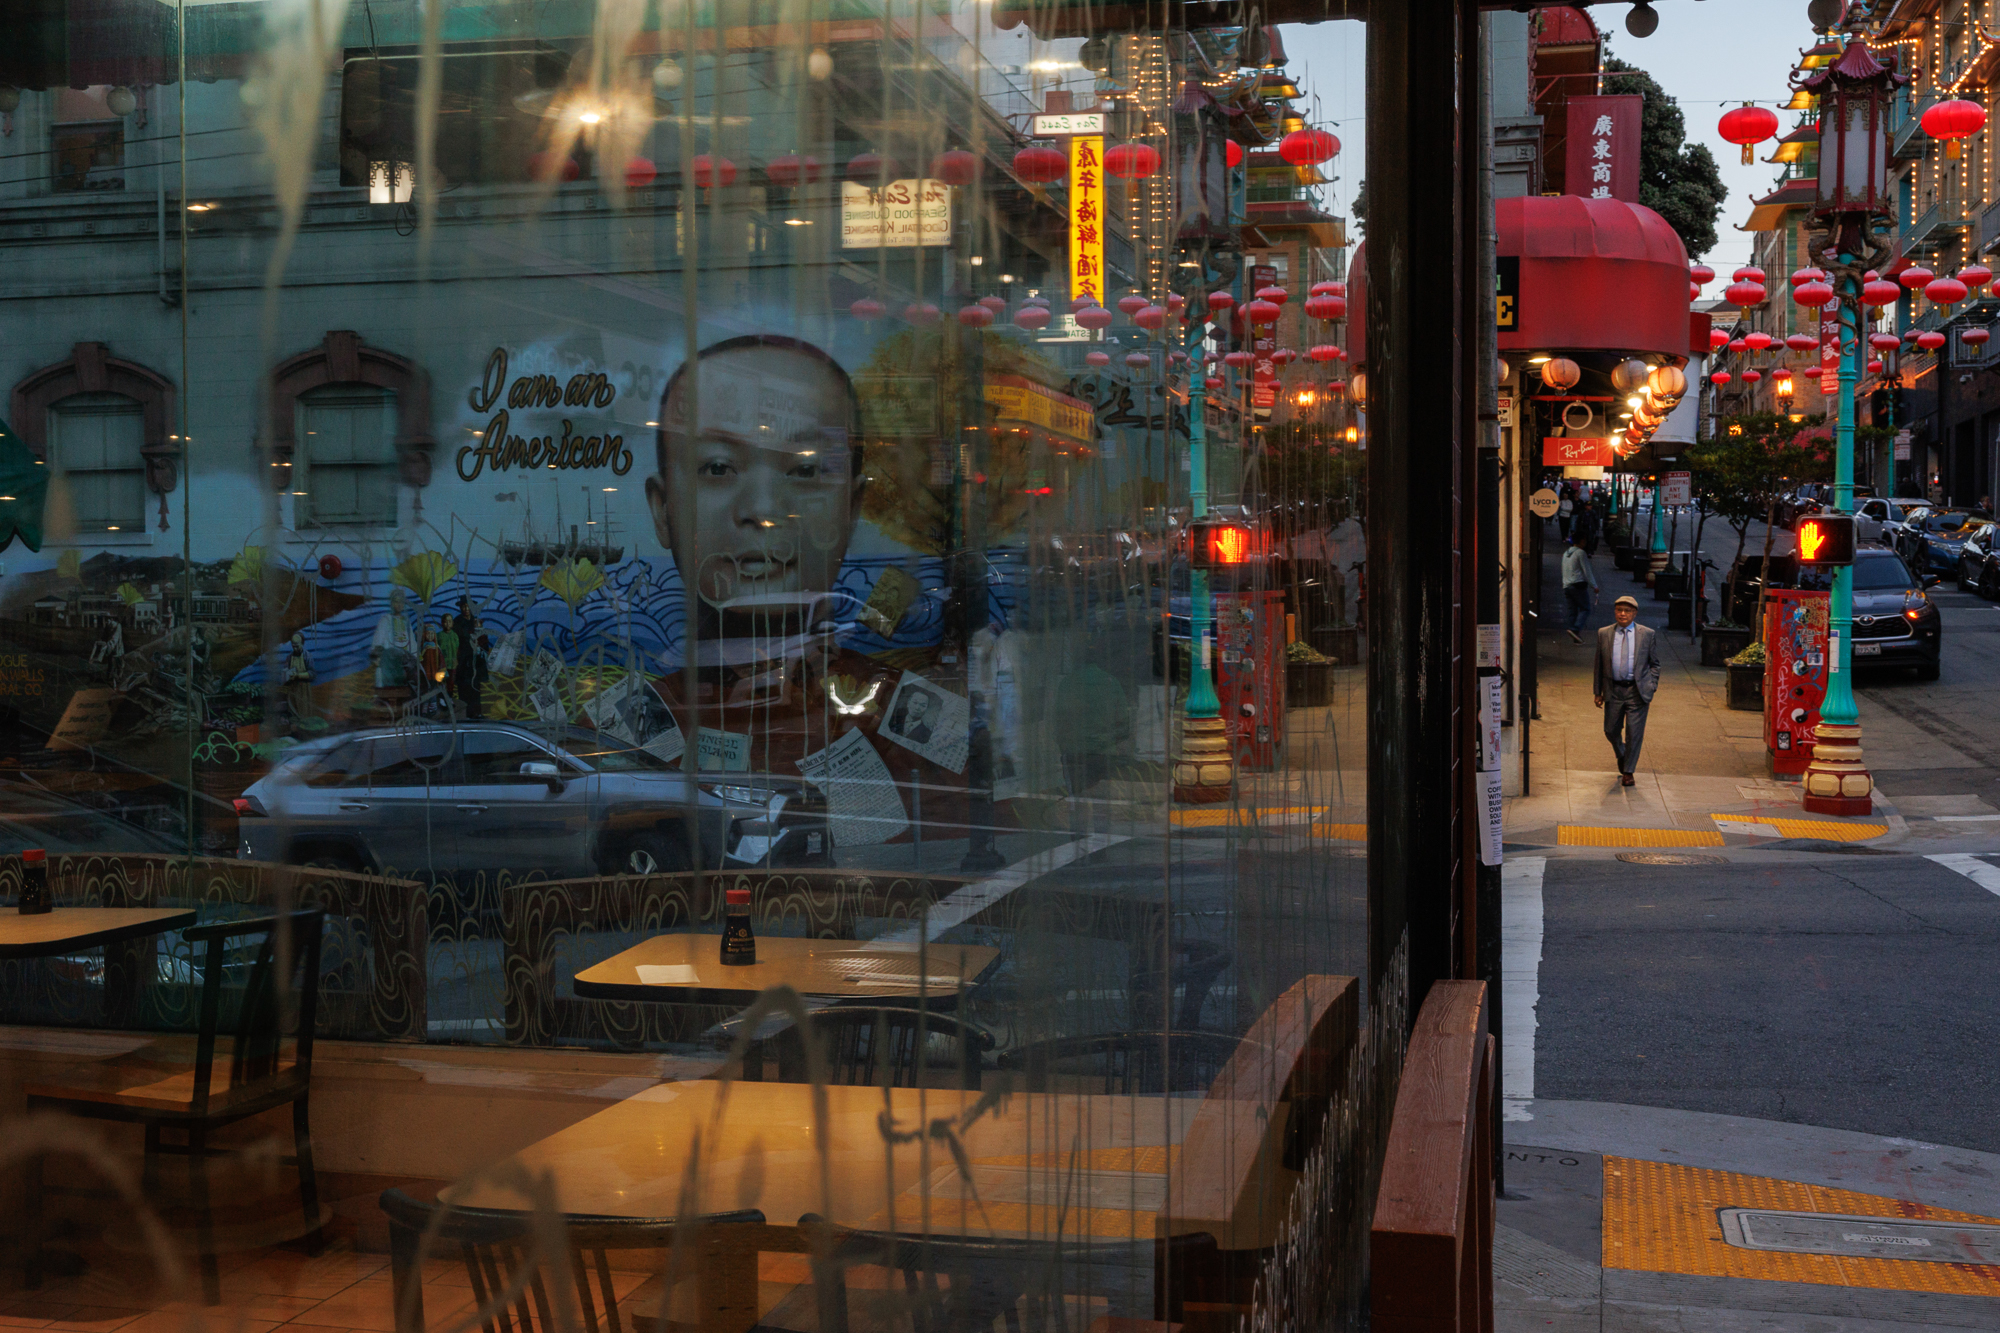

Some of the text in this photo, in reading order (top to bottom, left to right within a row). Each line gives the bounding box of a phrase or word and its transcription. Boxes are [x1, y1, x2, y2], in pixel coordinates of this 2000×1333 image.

[456, 409, 633, 481] American
[1560, 440, 1595, 458] Ray-Ban
[1533, 498, 1551, 506] Lyca
[9, 669, 44, 682] WALLS
[0, 682, 22, 695] RAL
[697, 734, 738, 750] ANGEL
[1504, 1152, 1579, 1166] NTO
